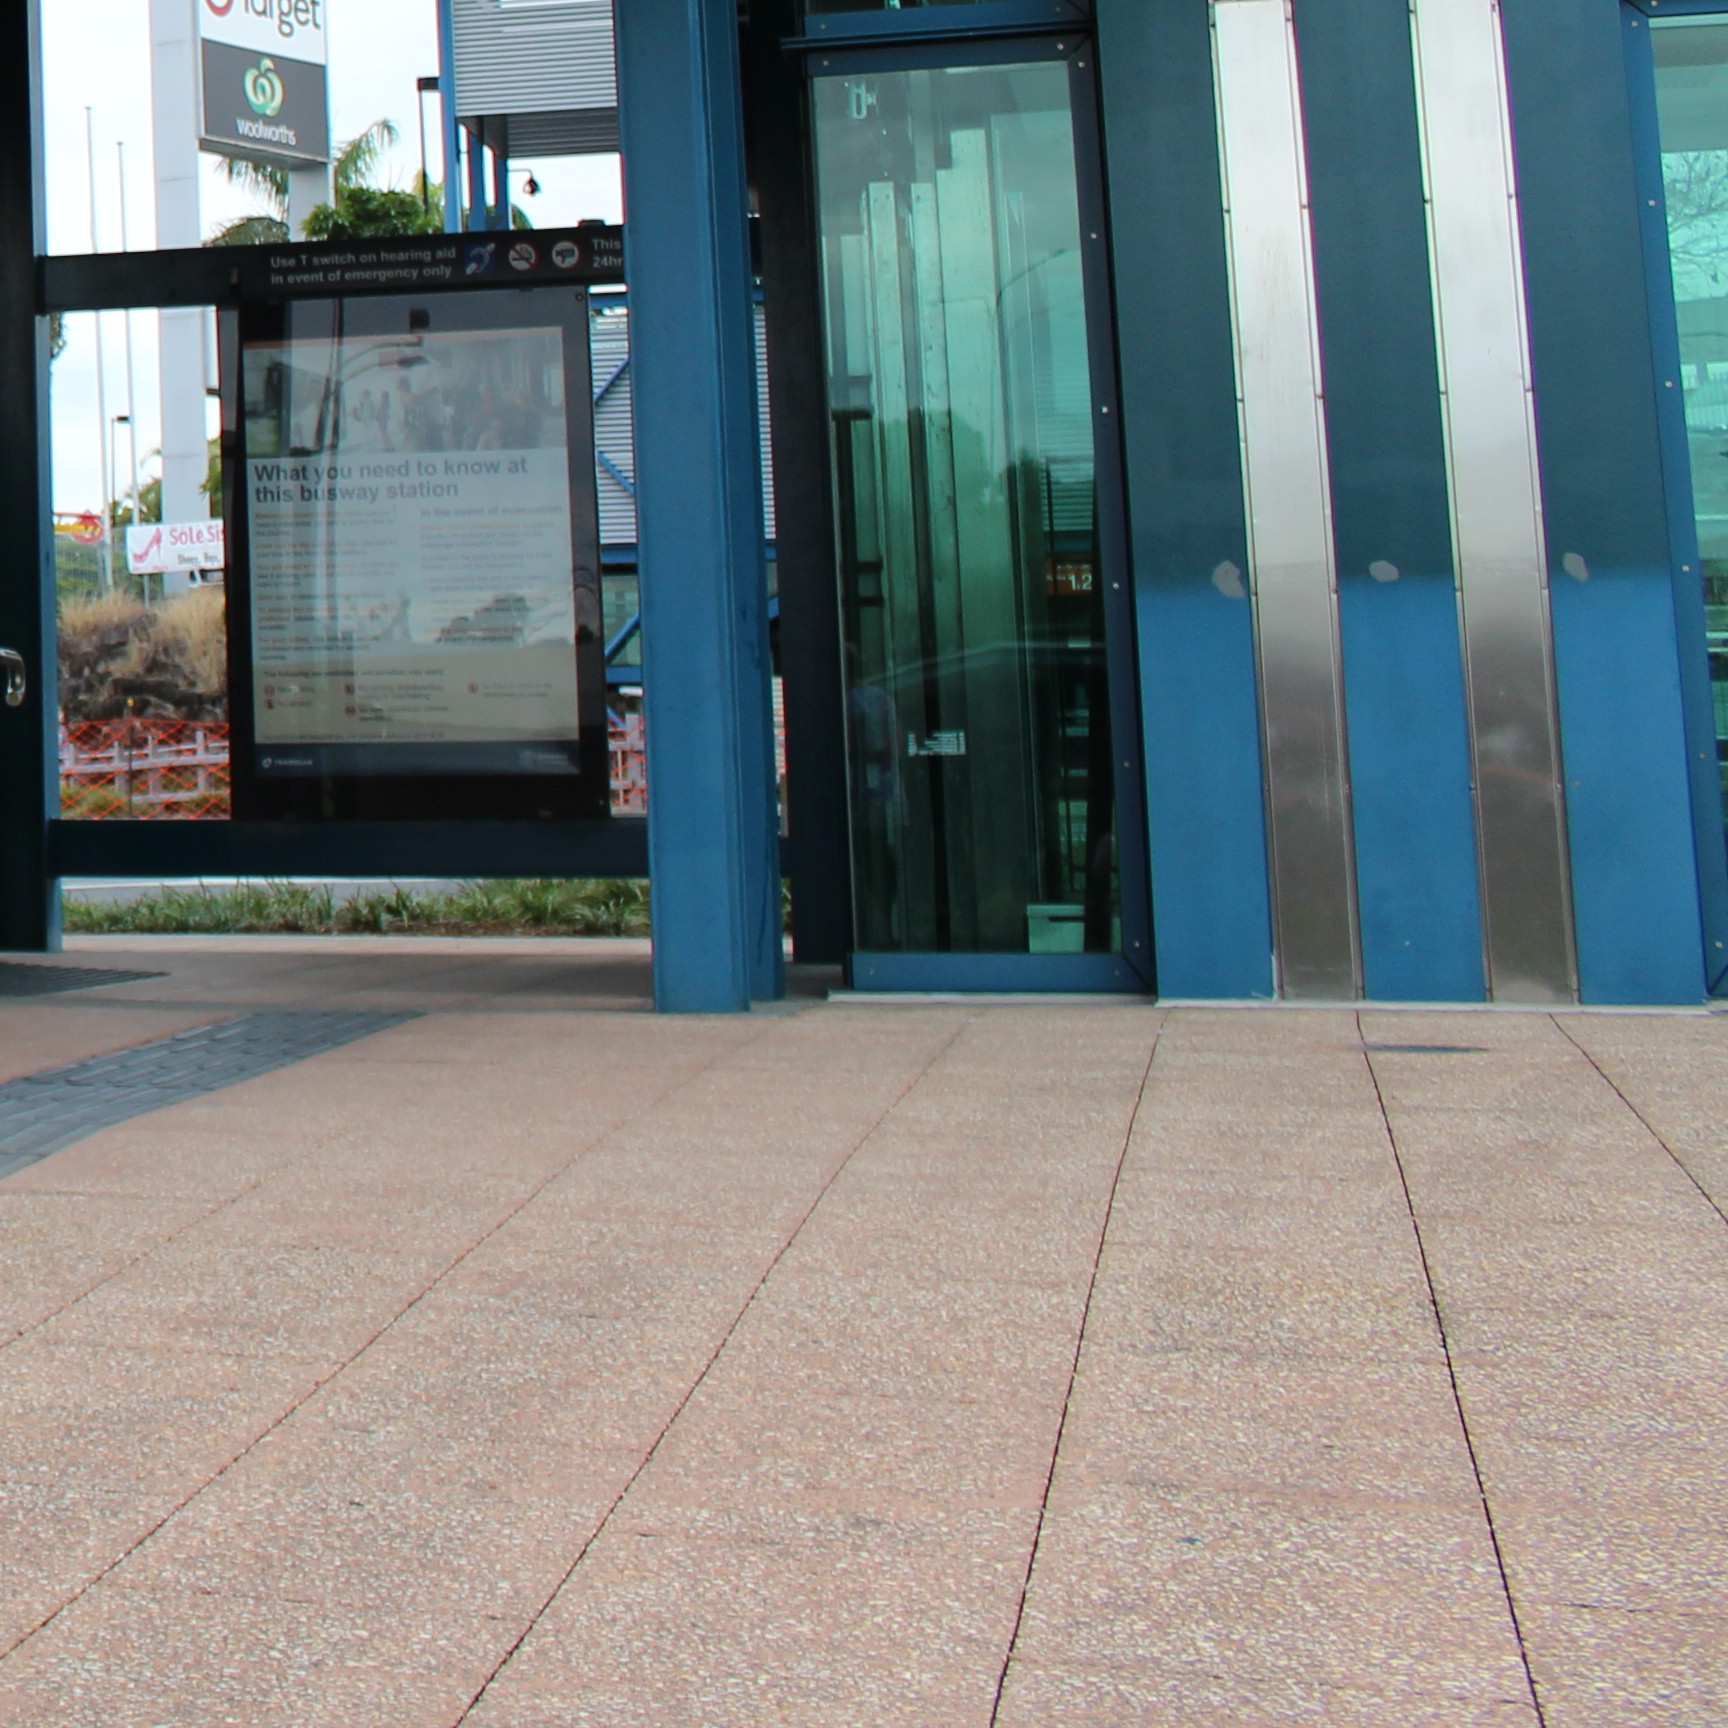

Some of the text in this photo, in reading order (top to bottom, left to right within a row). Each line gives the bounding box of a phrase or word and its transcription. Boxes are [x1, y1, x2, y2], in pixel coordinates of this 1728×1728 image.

[592, 238, 621, 251] This
[271, 247, 456, 268] Use T switch on hearing aid
[271, 265, 452, 284] in event of emergency only
[255, 457, 528, 485] What you need to know at
[255, 480, 459, 505] this busway station
[169, 526, 205, 546] Sole
